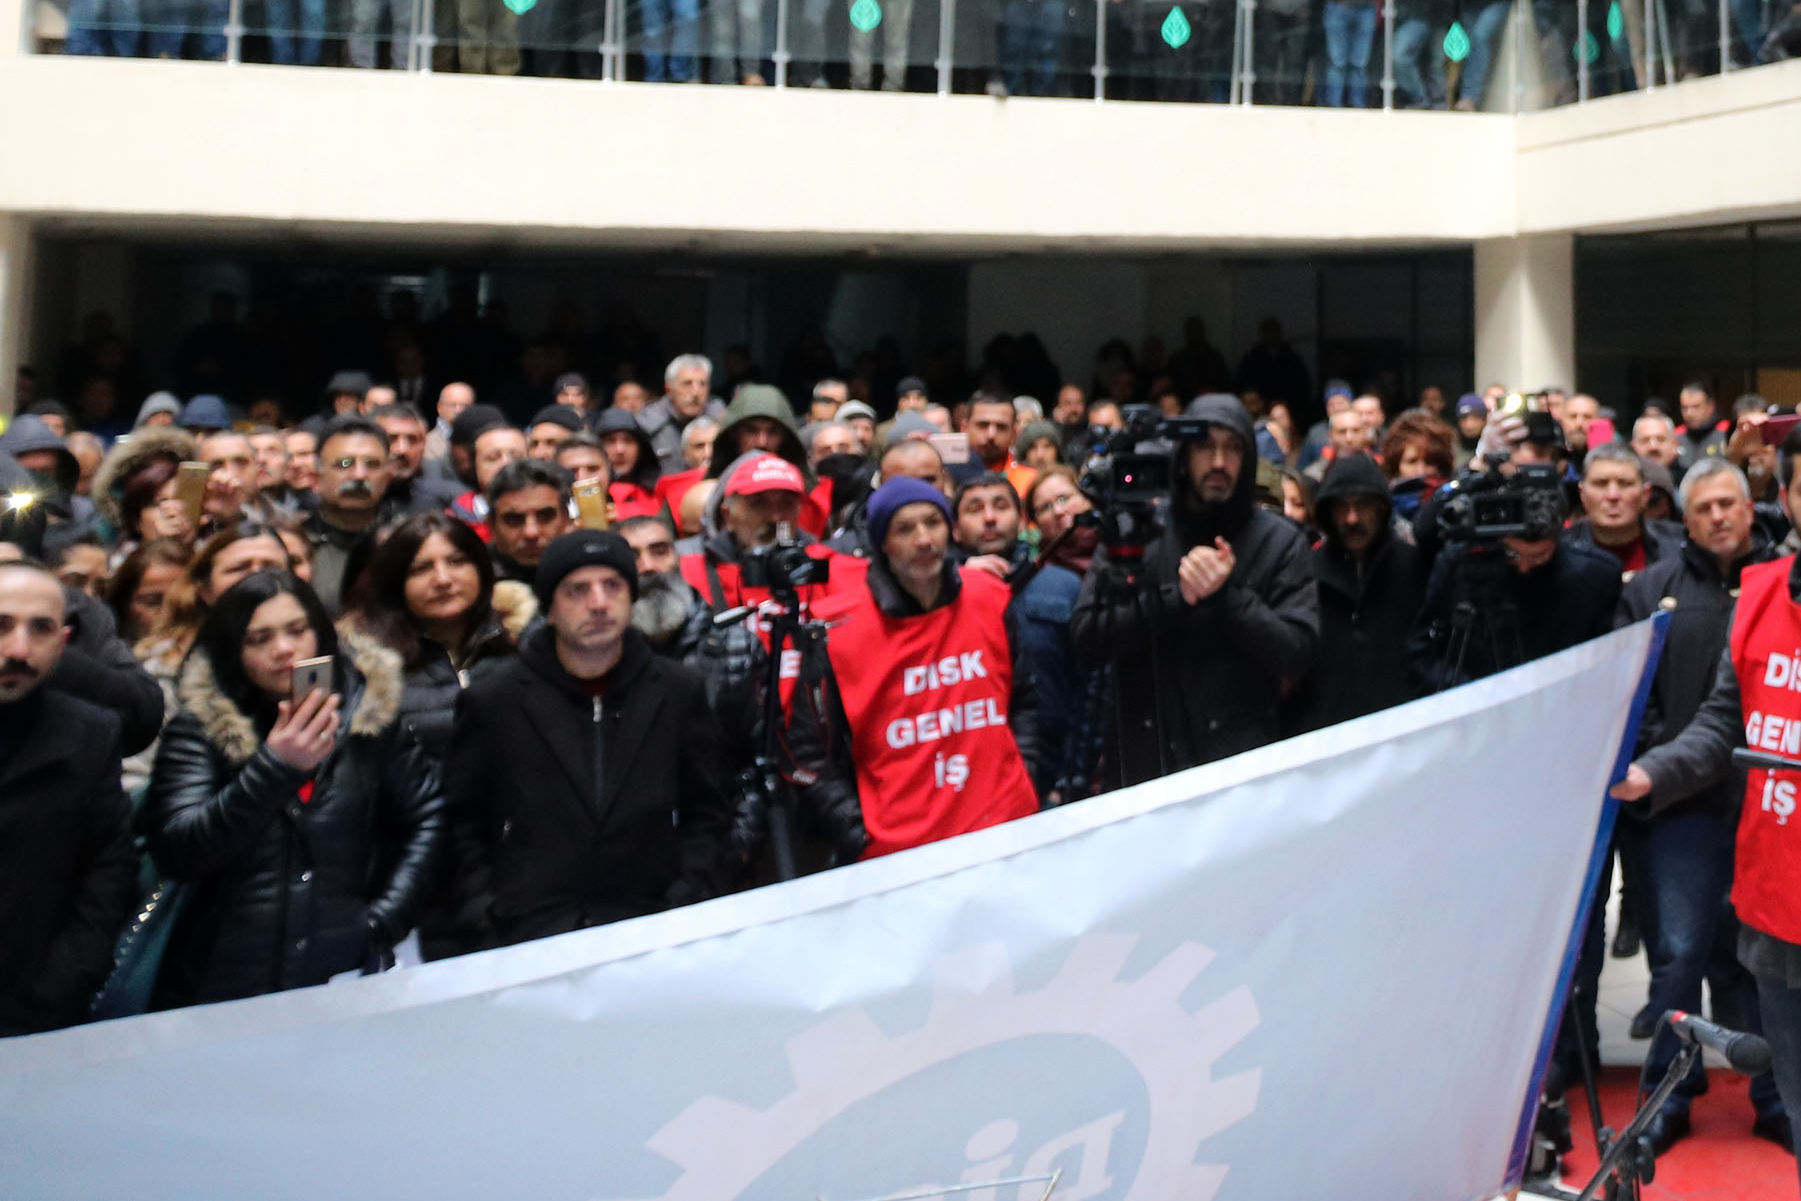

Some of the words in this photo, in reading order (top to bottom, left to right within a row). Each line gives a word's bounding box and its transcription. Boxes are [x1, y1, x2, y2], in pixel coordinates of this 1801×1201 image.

[885, 697, 1007, 750] GENEL
[934, 751, 970, 793] İŞ
[1761, 767, 1798, 826] İŞ
